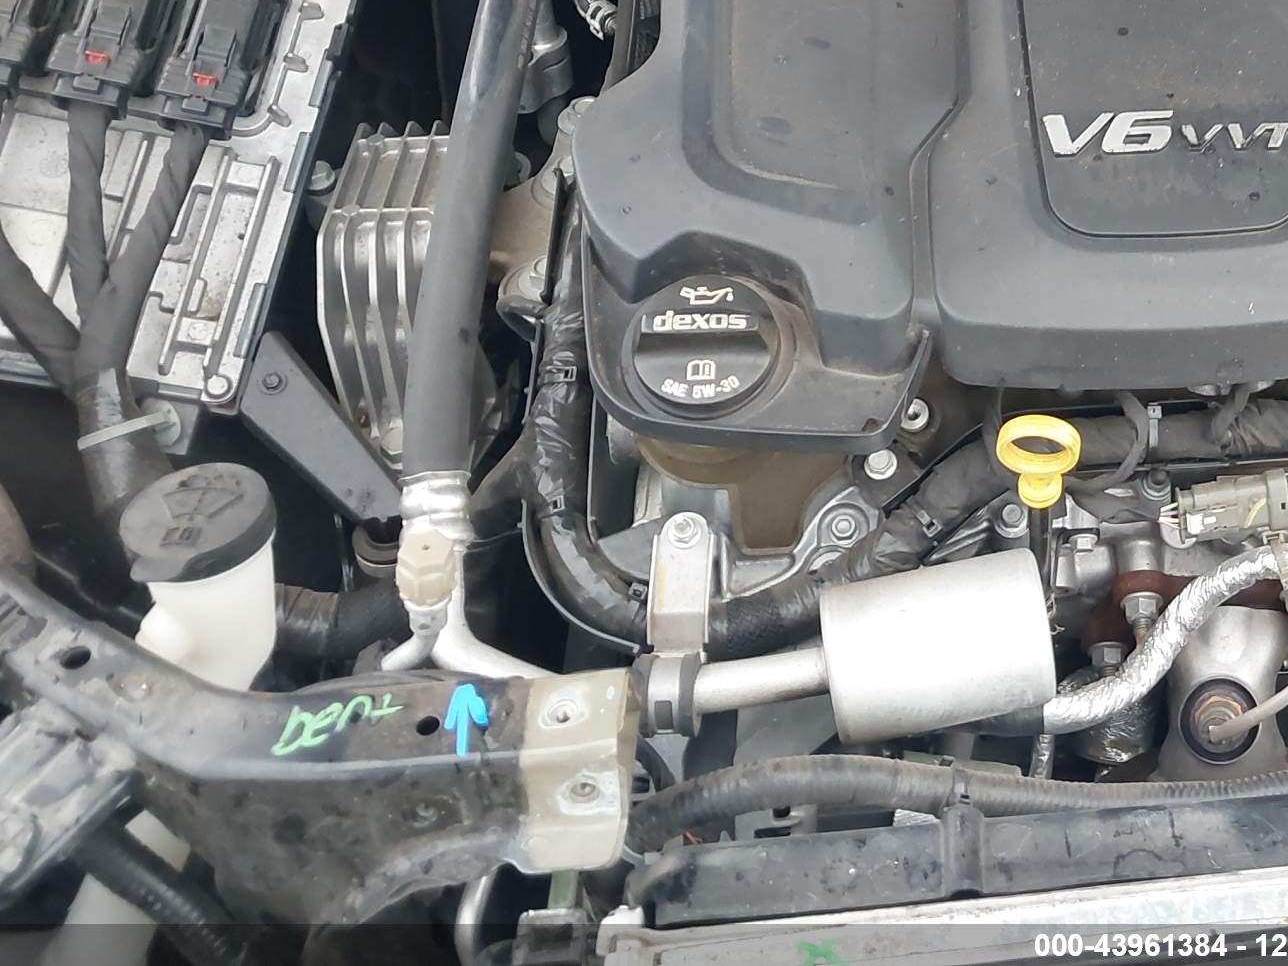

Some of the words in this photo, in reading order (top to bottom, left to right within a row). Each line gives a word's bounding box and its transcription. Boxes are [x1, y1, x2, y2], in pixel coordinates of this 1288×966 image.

[1042, 110, 1174, 157] V6
[653, 310, 747, 331] dexos
[661, 379, 689, 398] SAE
[692, 375, 740, 399] 5W-30
